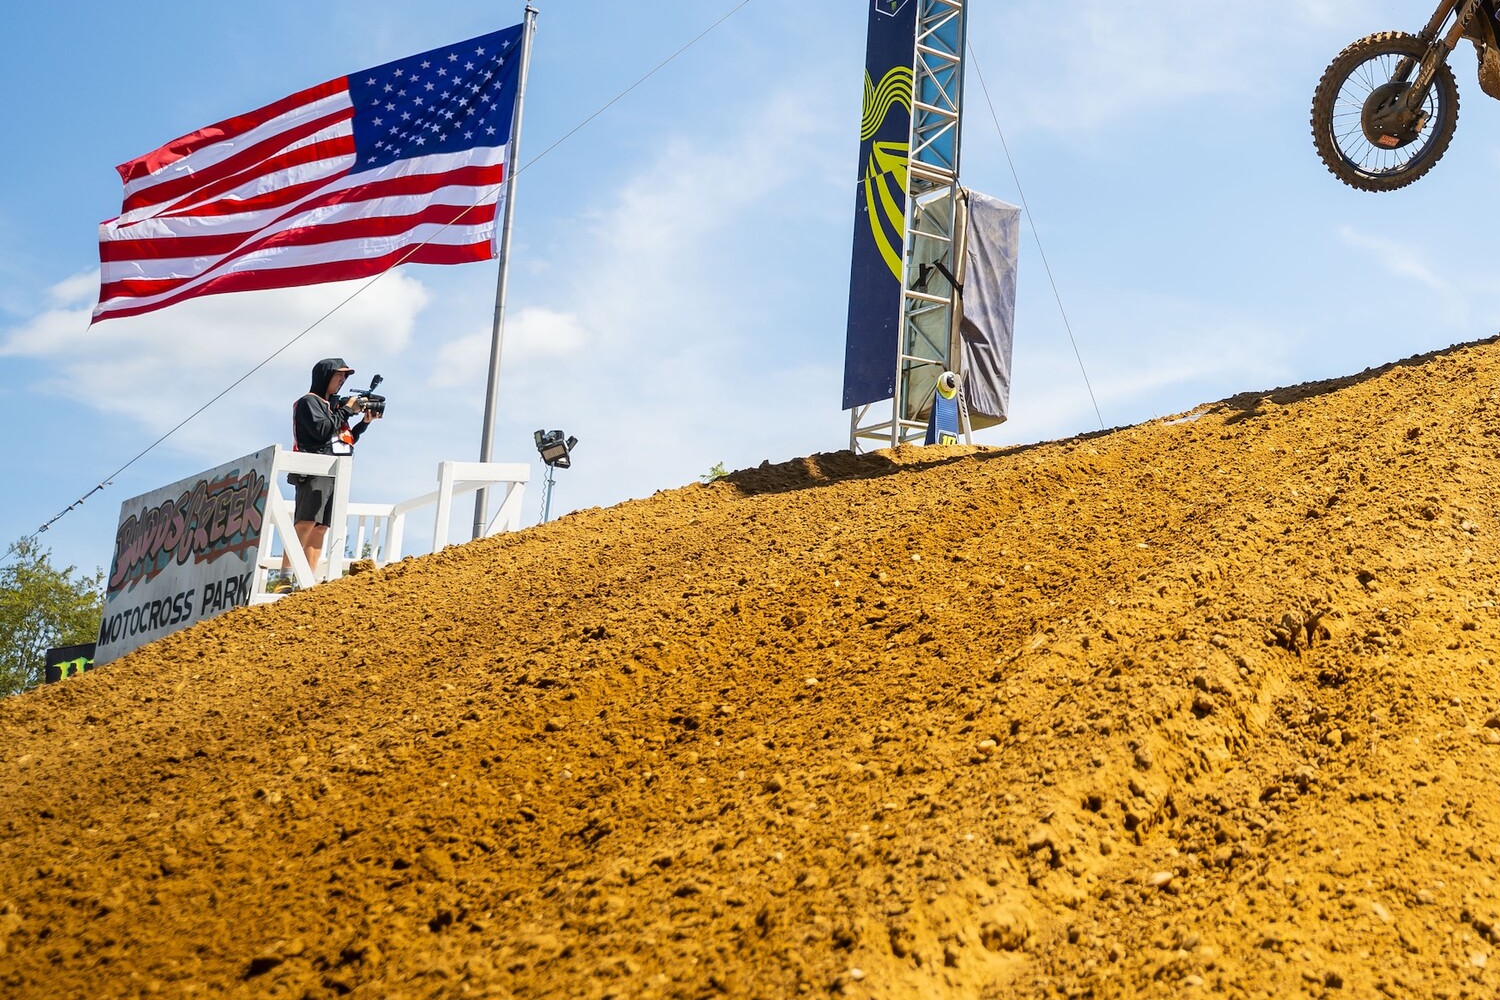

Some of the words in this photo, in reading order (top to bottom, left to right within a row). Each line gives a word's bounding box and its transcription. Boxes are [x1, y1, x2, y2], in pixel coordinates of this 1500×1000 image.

[110, 490, 190, 588] BUDDS
[176, 468, 265, 567] CREEK
[97, 588, 195, 647] MOTOCROSS
[200, 571, 253, 616] PARK
